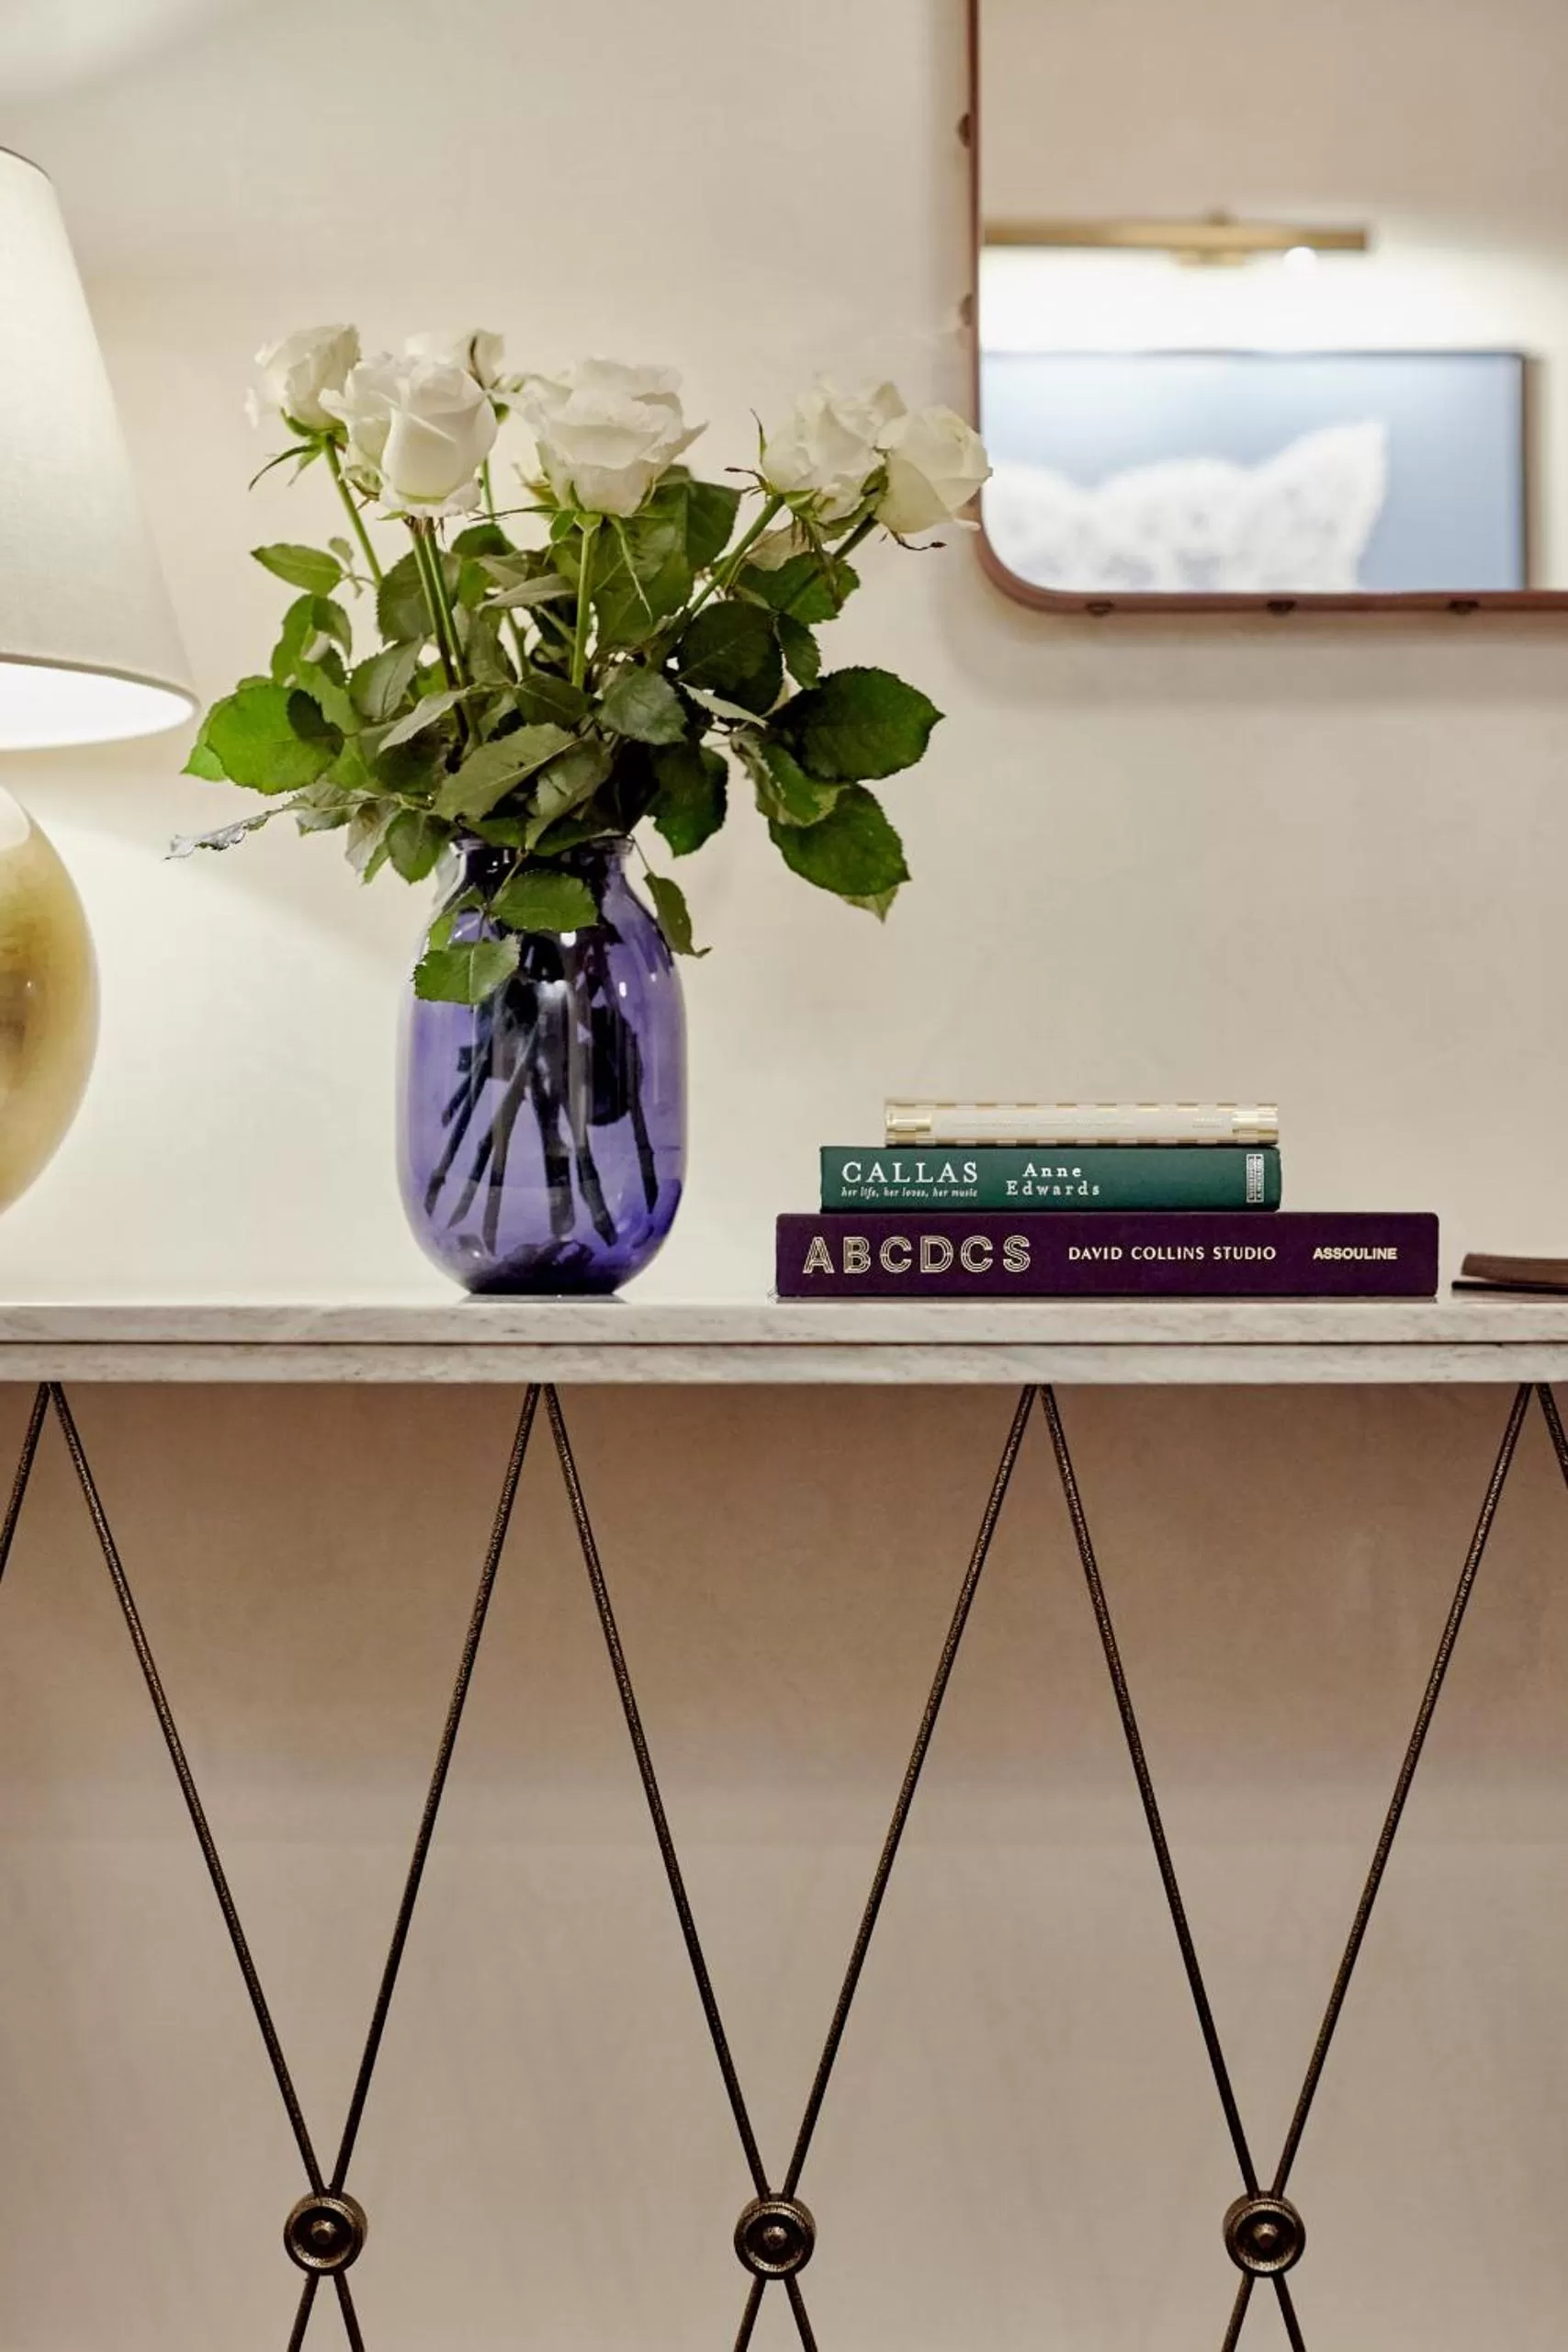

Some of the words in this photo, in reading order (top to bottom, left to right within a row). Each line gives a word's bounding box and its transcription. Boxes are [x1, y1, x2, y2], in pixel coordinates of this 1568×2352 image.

[841, 1160, 978, 1183] CALLAS
[1021, 1161, 1083, 1178] Anne
[840, 1186, 858, 1197] her
[883, 1186, 899, 1198] her
[932, 1186, 949, 1198] her
[1006, 1180, 1100, 1196] Edwards
[802, 1235, 1032, 1274] ABCDCS
[1068, 1246, 1123, 1261] DAVID
[1131, 1246, 1205, 1261] COLLINS
[1213, 1246, 1277, 1261] STUDIO
[1312, 1247, 1398, 1261] ASSOULINE
